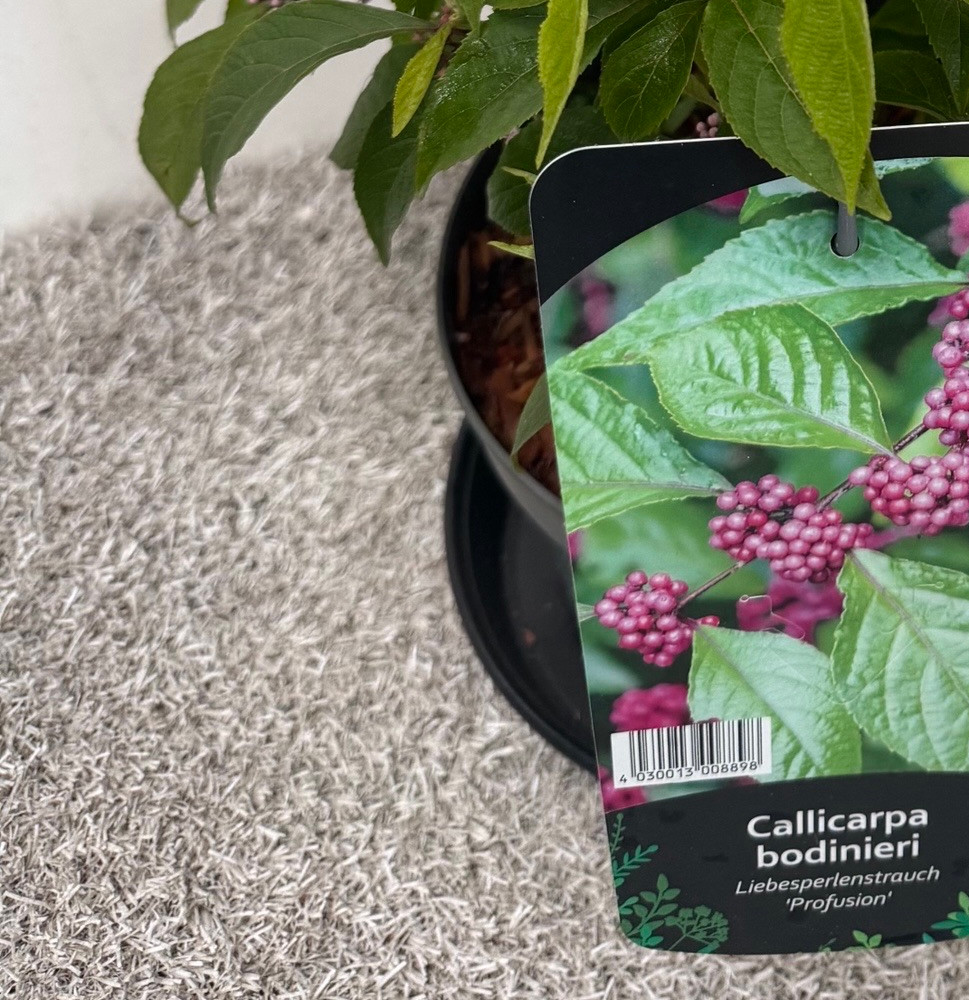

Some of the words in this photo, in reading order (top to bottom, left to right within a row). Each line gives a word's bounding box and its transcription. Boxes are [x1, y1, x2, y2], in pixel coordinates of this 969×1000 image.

[619, 774, 627, 784] 4
[636, 767, 694, 782] 030013
[701, 761, 758, 775] 008898
[746, 808, 928, 838] Callicarpa
[757, 833, 920, 868] bodinieri
[735, 865, 940, 895] Liebesperlenstrauch
[786, 891, 893, 913] 'Profusion'
